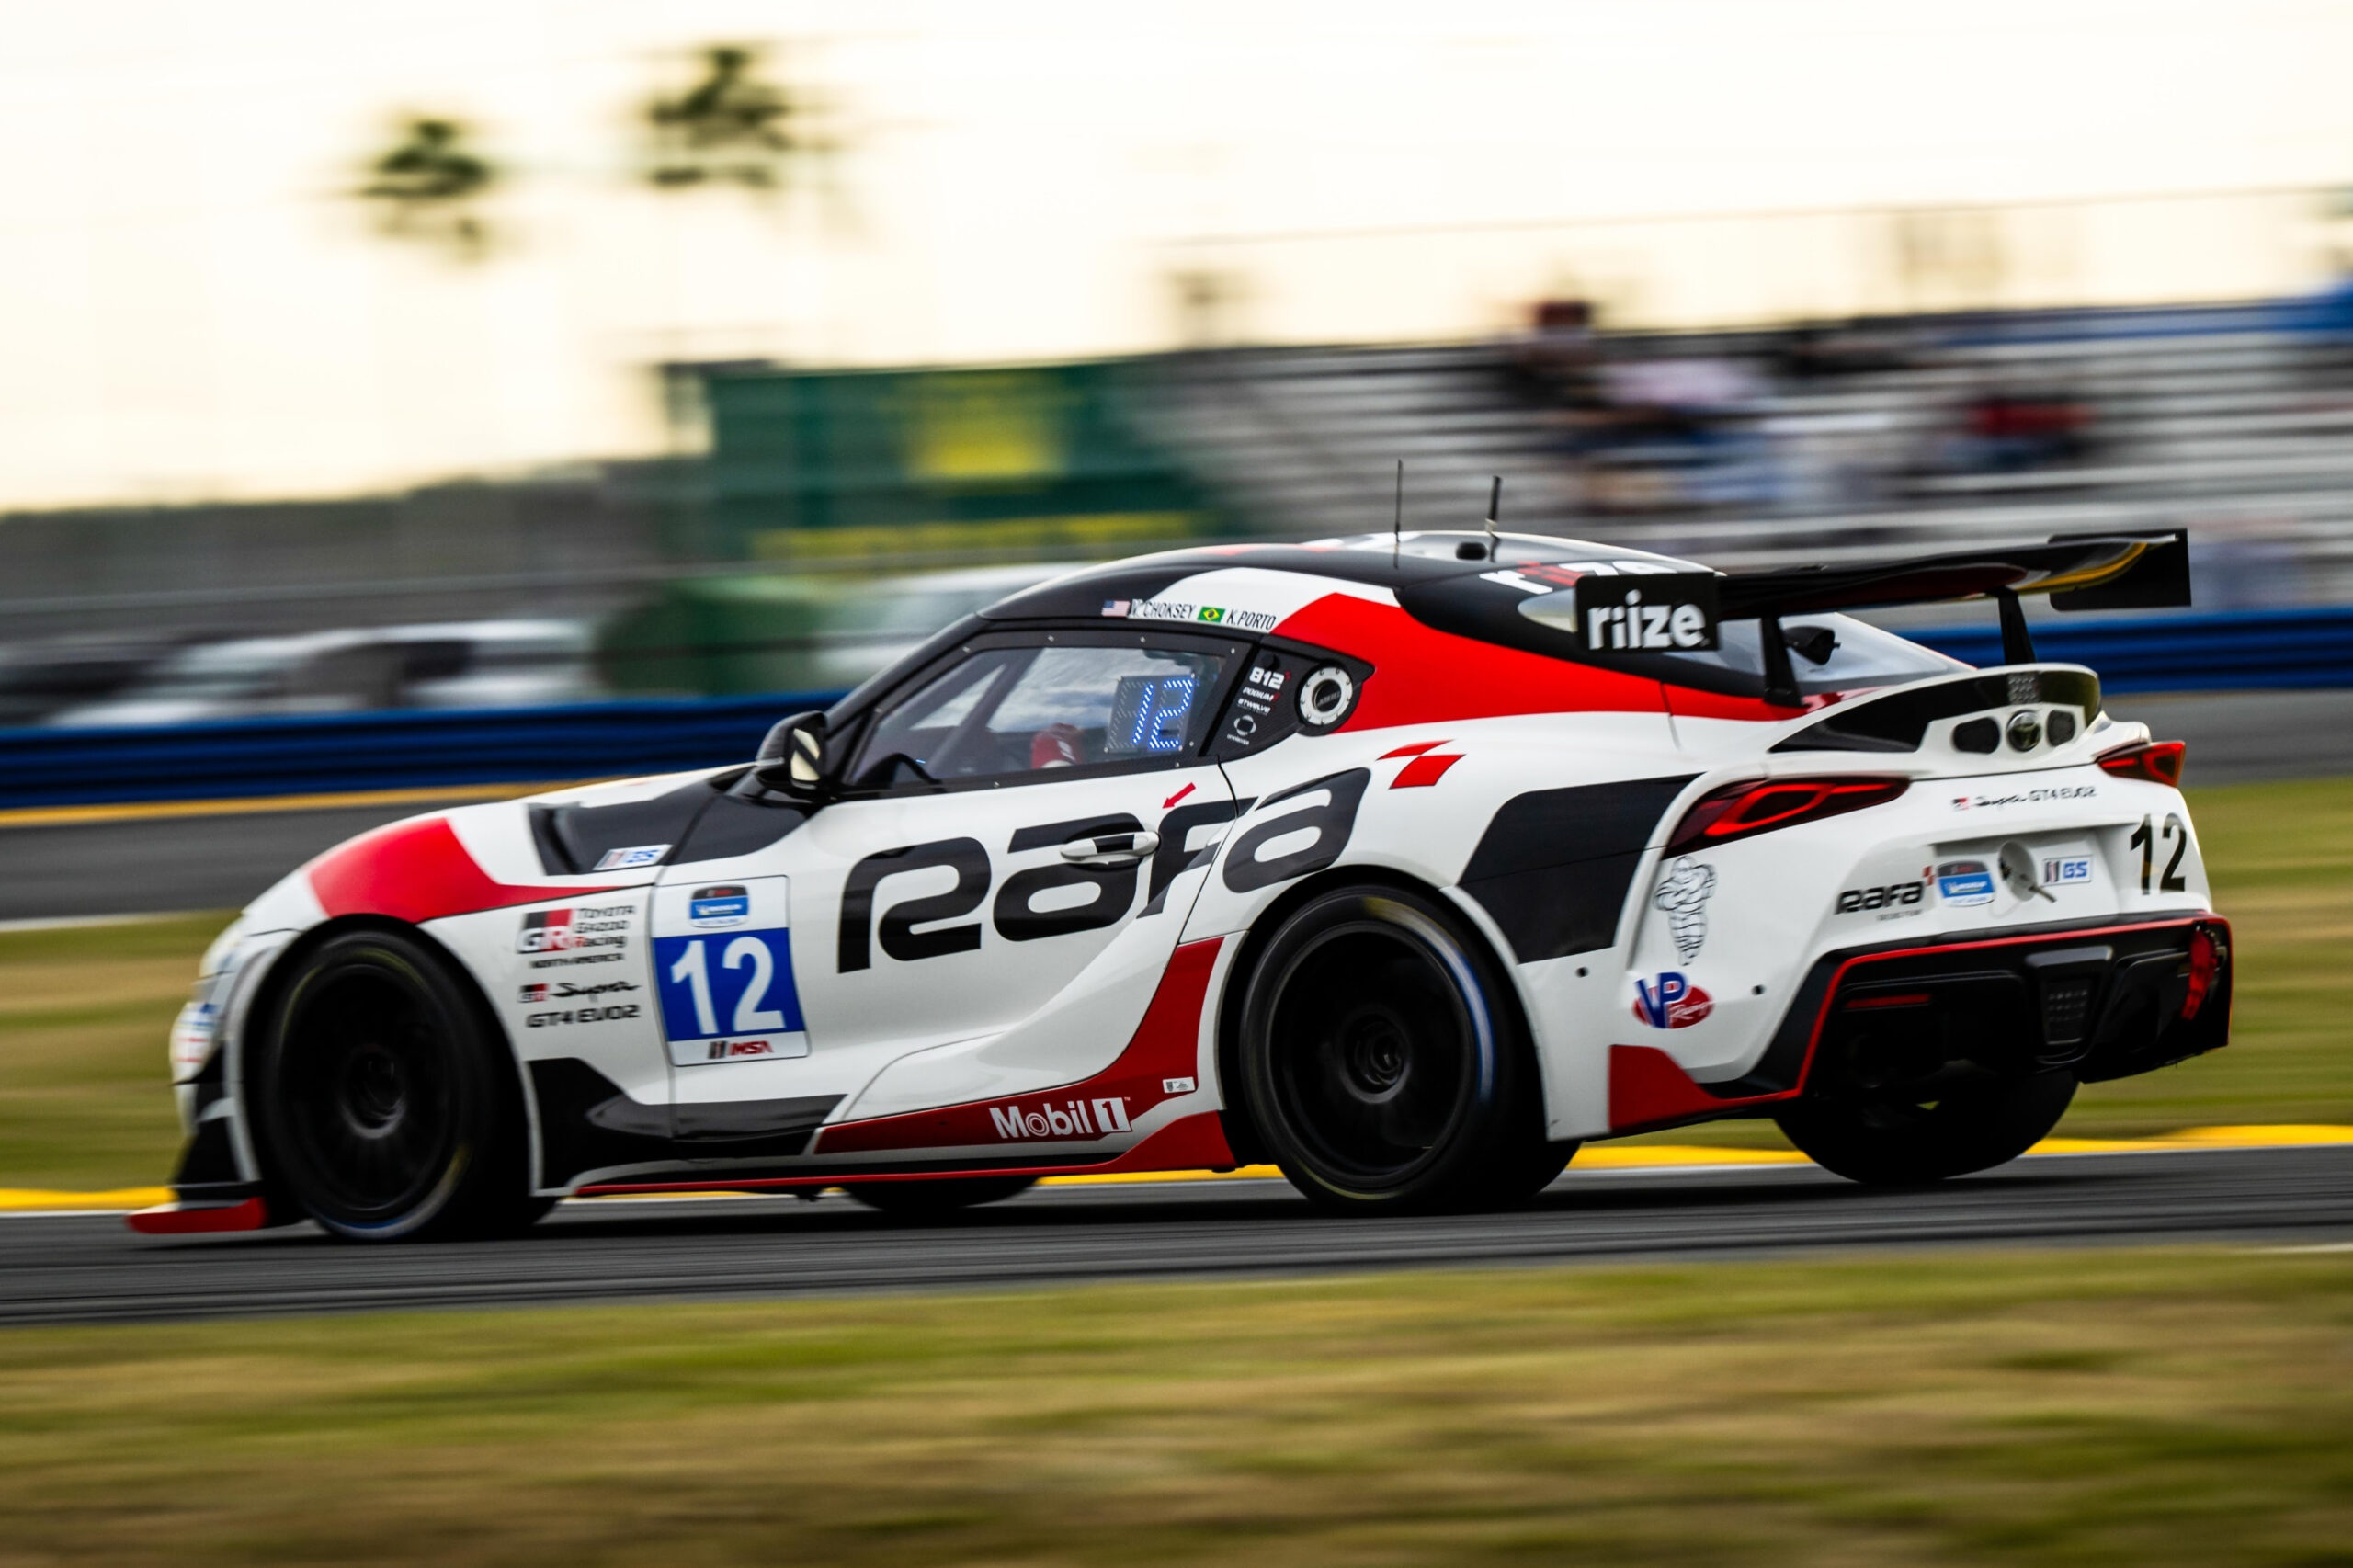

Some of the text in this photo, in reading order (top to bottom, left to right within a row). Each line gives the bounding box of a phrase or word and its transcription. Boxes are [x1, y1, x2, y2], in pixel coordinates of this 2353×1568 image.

[1226, 608, 1277, 630] K.PORTO
[1587, 589, 1707, 650] riize
[1249, 666, 1285, 690] 812
[1132, 679, 1193, 748] 12
[2063, 861, 2088, 879] GS
[2130, 812, 2187, 895] 12
[670, 937, 785, 1035] 12
[1634, 971, 1688, 1029] VP
[526, 1012, 574, 1028] GT4
[989, 1100, 1094, 1139] Mobil
